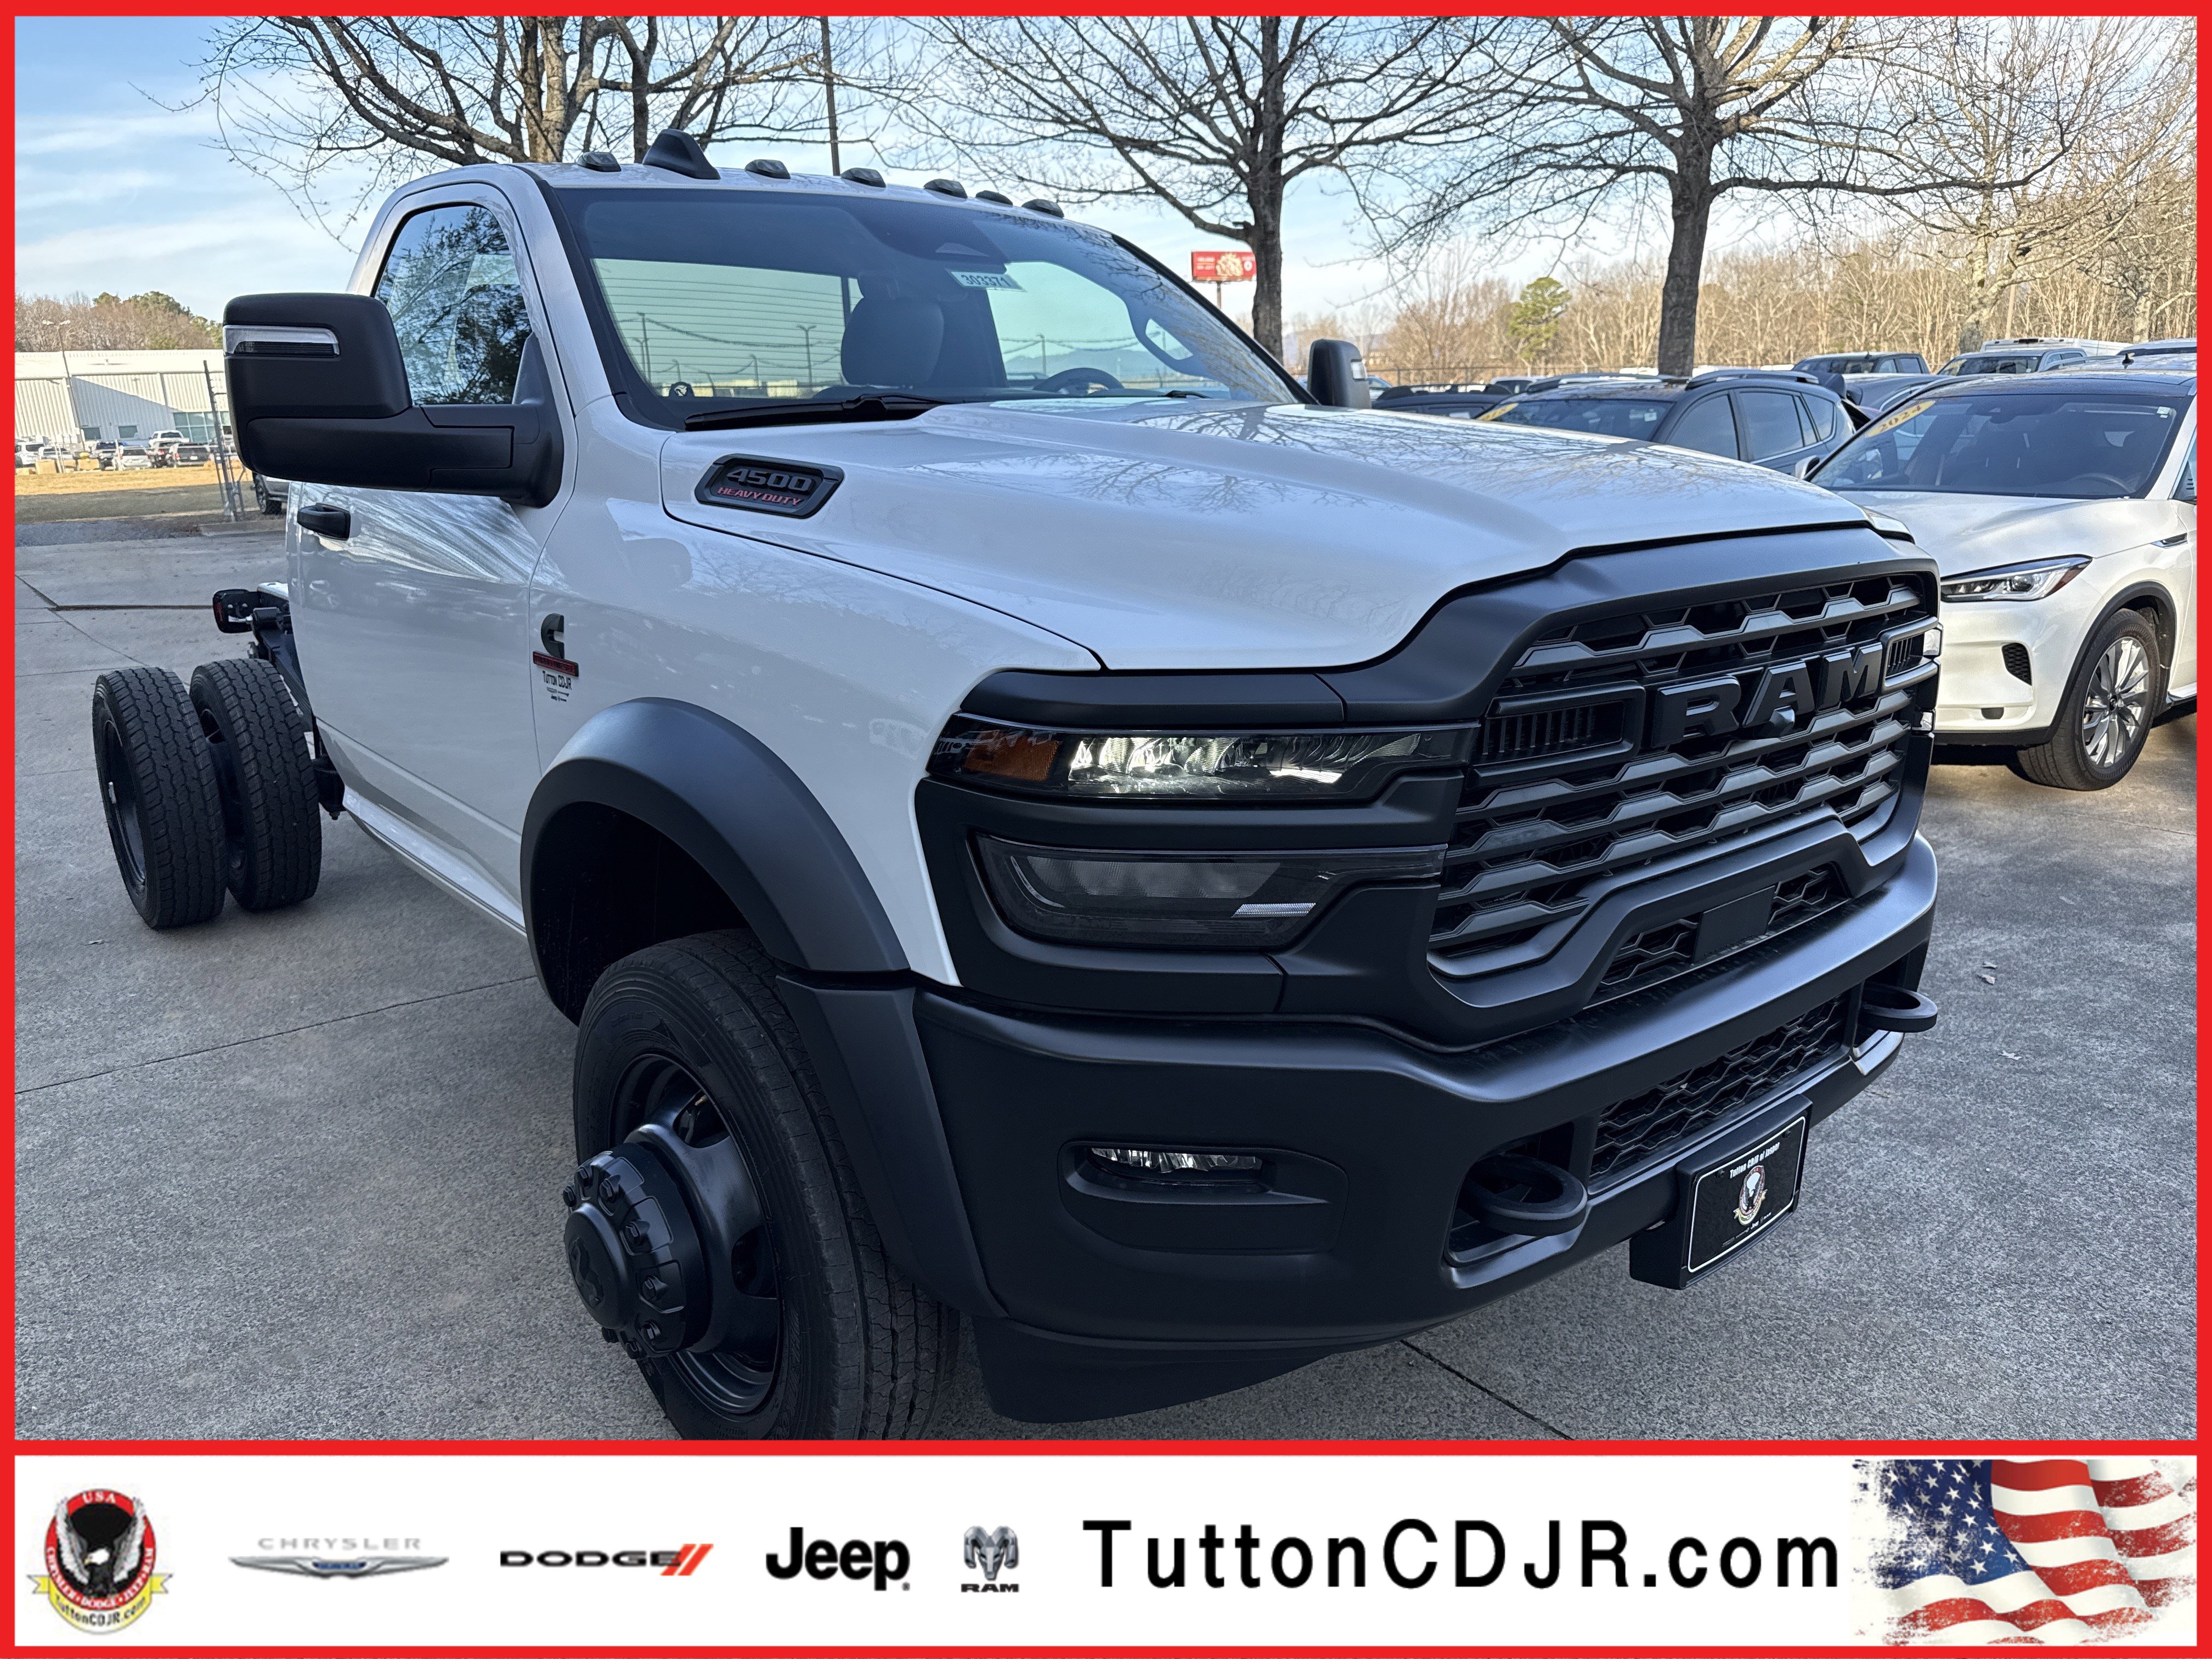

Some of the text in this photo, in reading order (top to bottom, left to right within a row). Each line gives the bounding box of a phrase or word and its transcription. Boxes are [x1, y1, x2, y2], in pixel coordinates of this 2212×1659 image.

[961, 275, 1012, 287] 303371
[1878, 404, 1922, 432] 2024
[726, 468, 812, 493] 4500
[718, 487, 802, 506] HEAVY DUTY
[1651, 642, 1883, 748] RAM
[1730, 1163, 1747, 1179] Tutton
